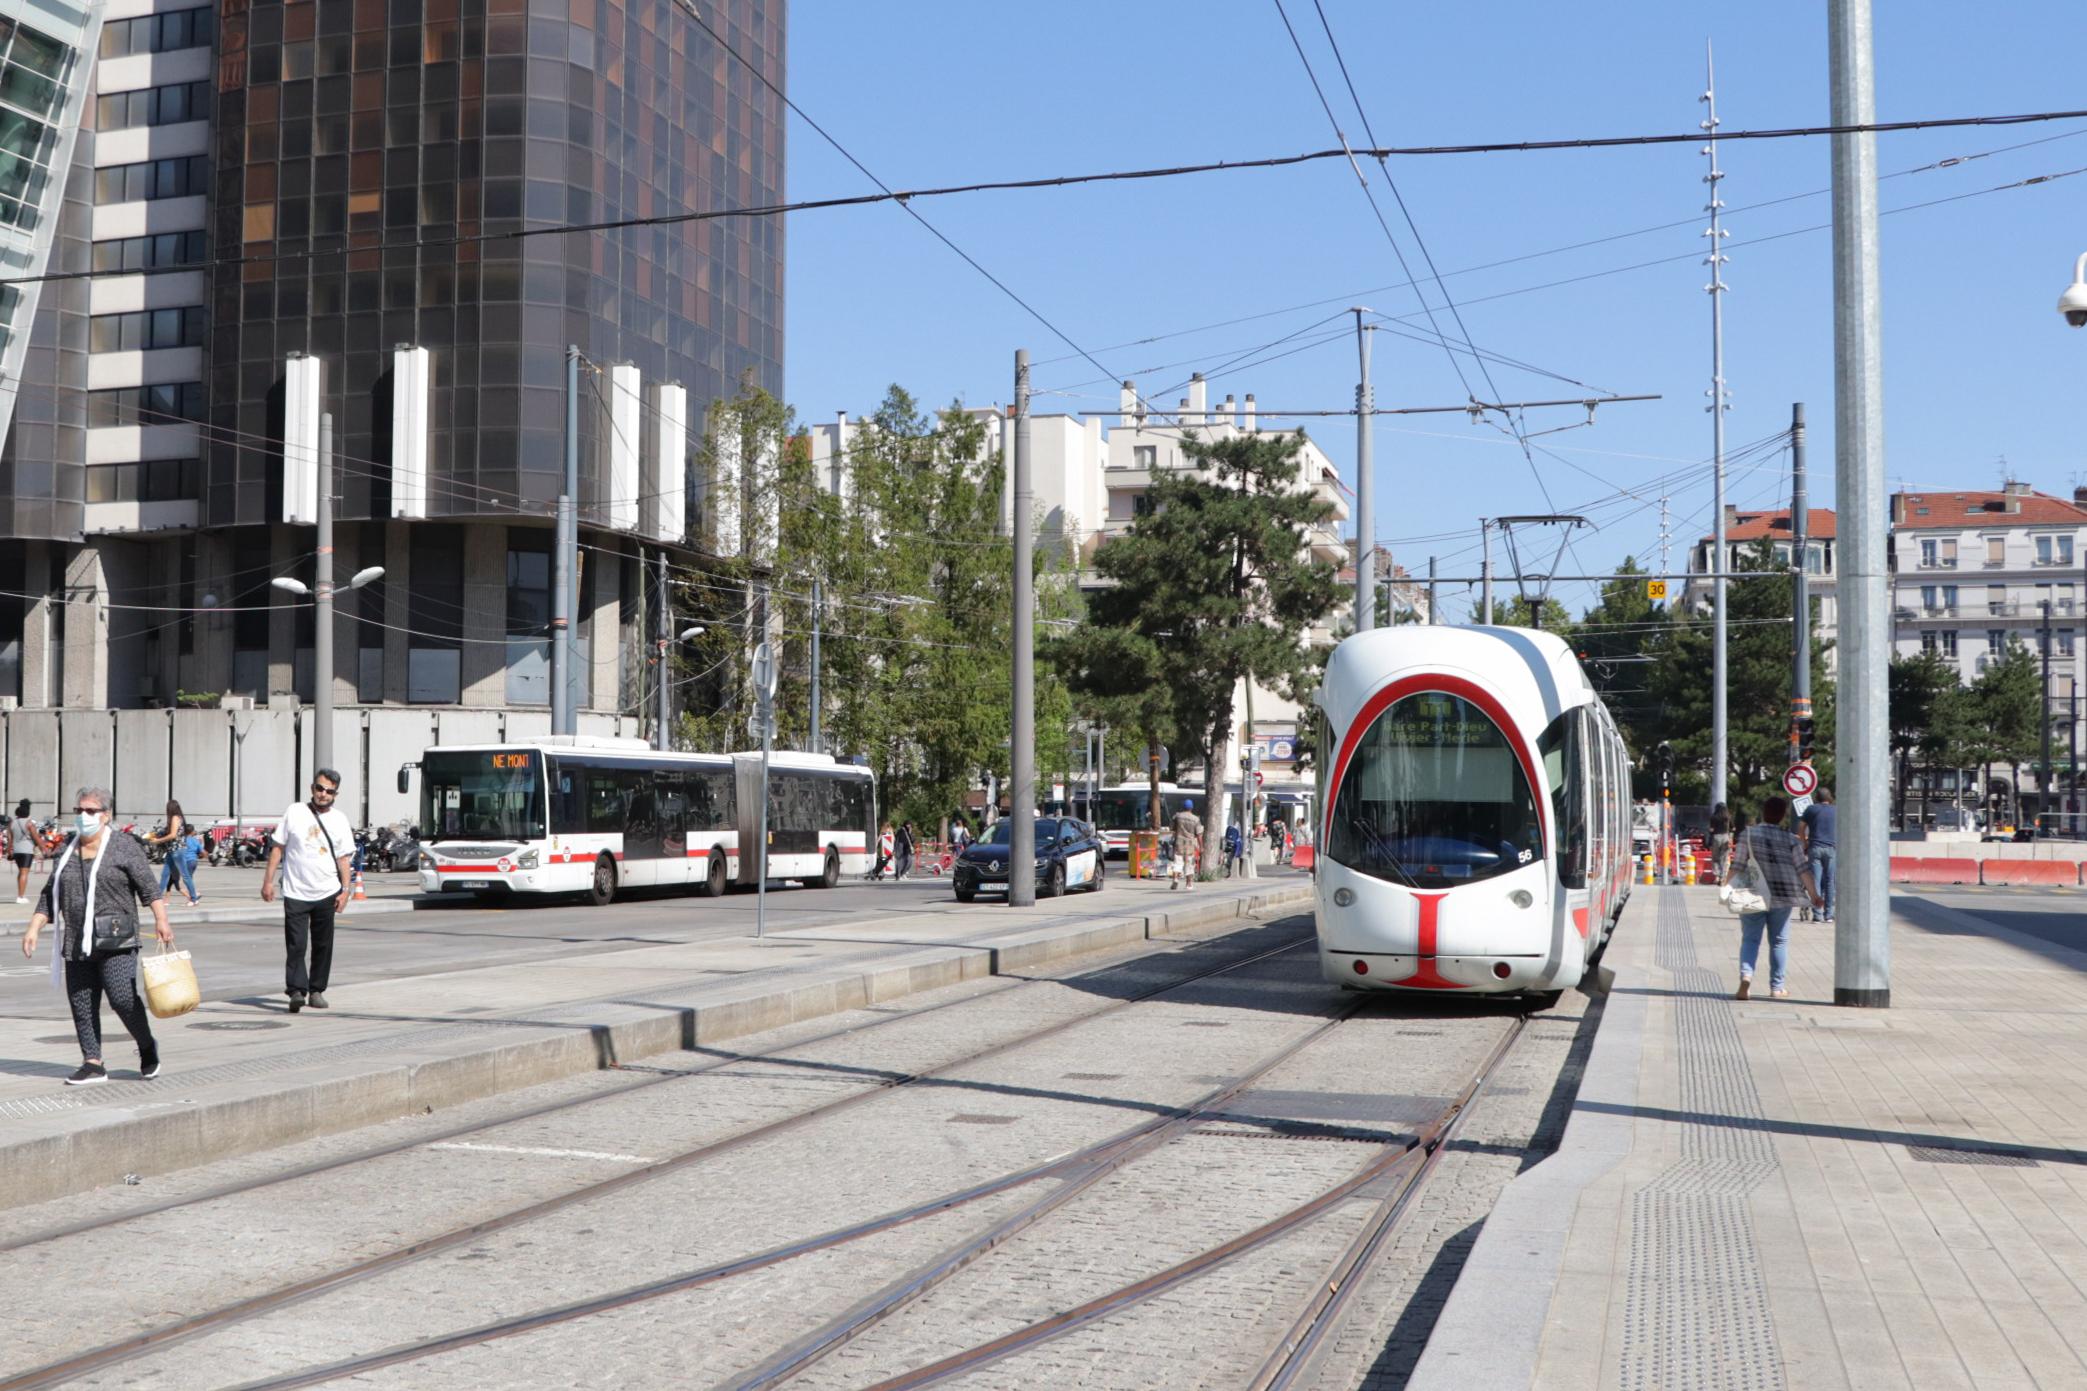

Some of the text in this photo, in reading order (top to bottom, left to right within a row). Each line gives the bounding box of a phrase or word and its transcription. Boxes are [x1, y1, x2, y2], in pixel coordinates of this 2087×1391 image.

[1650, 584, 1665, 595] 30
[1421, 721, 1488, 732] Part-Dieu
[493, 754, 505, 768] NE
[1518, 849, 1532, 863] 56
